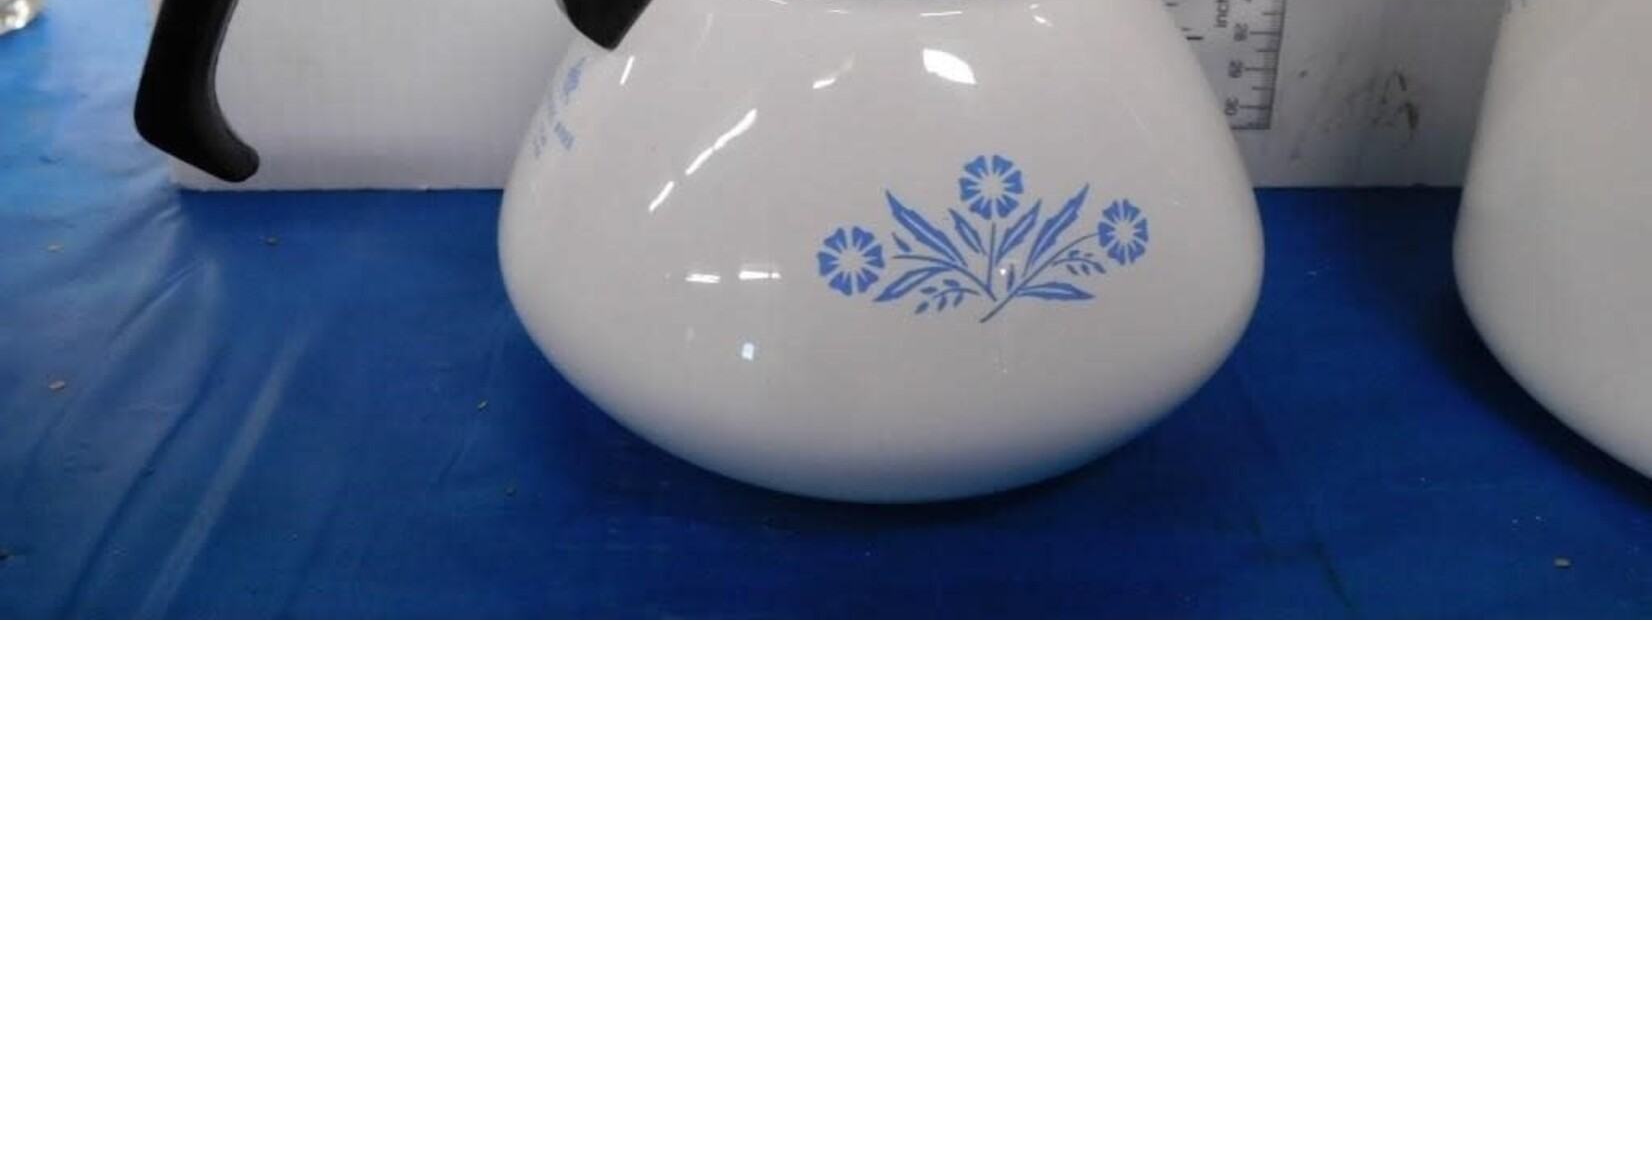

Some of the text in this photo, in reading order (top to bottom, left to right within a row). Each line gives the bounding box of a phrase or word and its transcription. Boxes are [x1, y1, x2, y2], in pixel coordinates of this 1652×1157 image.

[1233, 23, 1249, 42] 28
[1228, 60, 1244, 79] 29
[1224, 97, 1239, 116] 30
